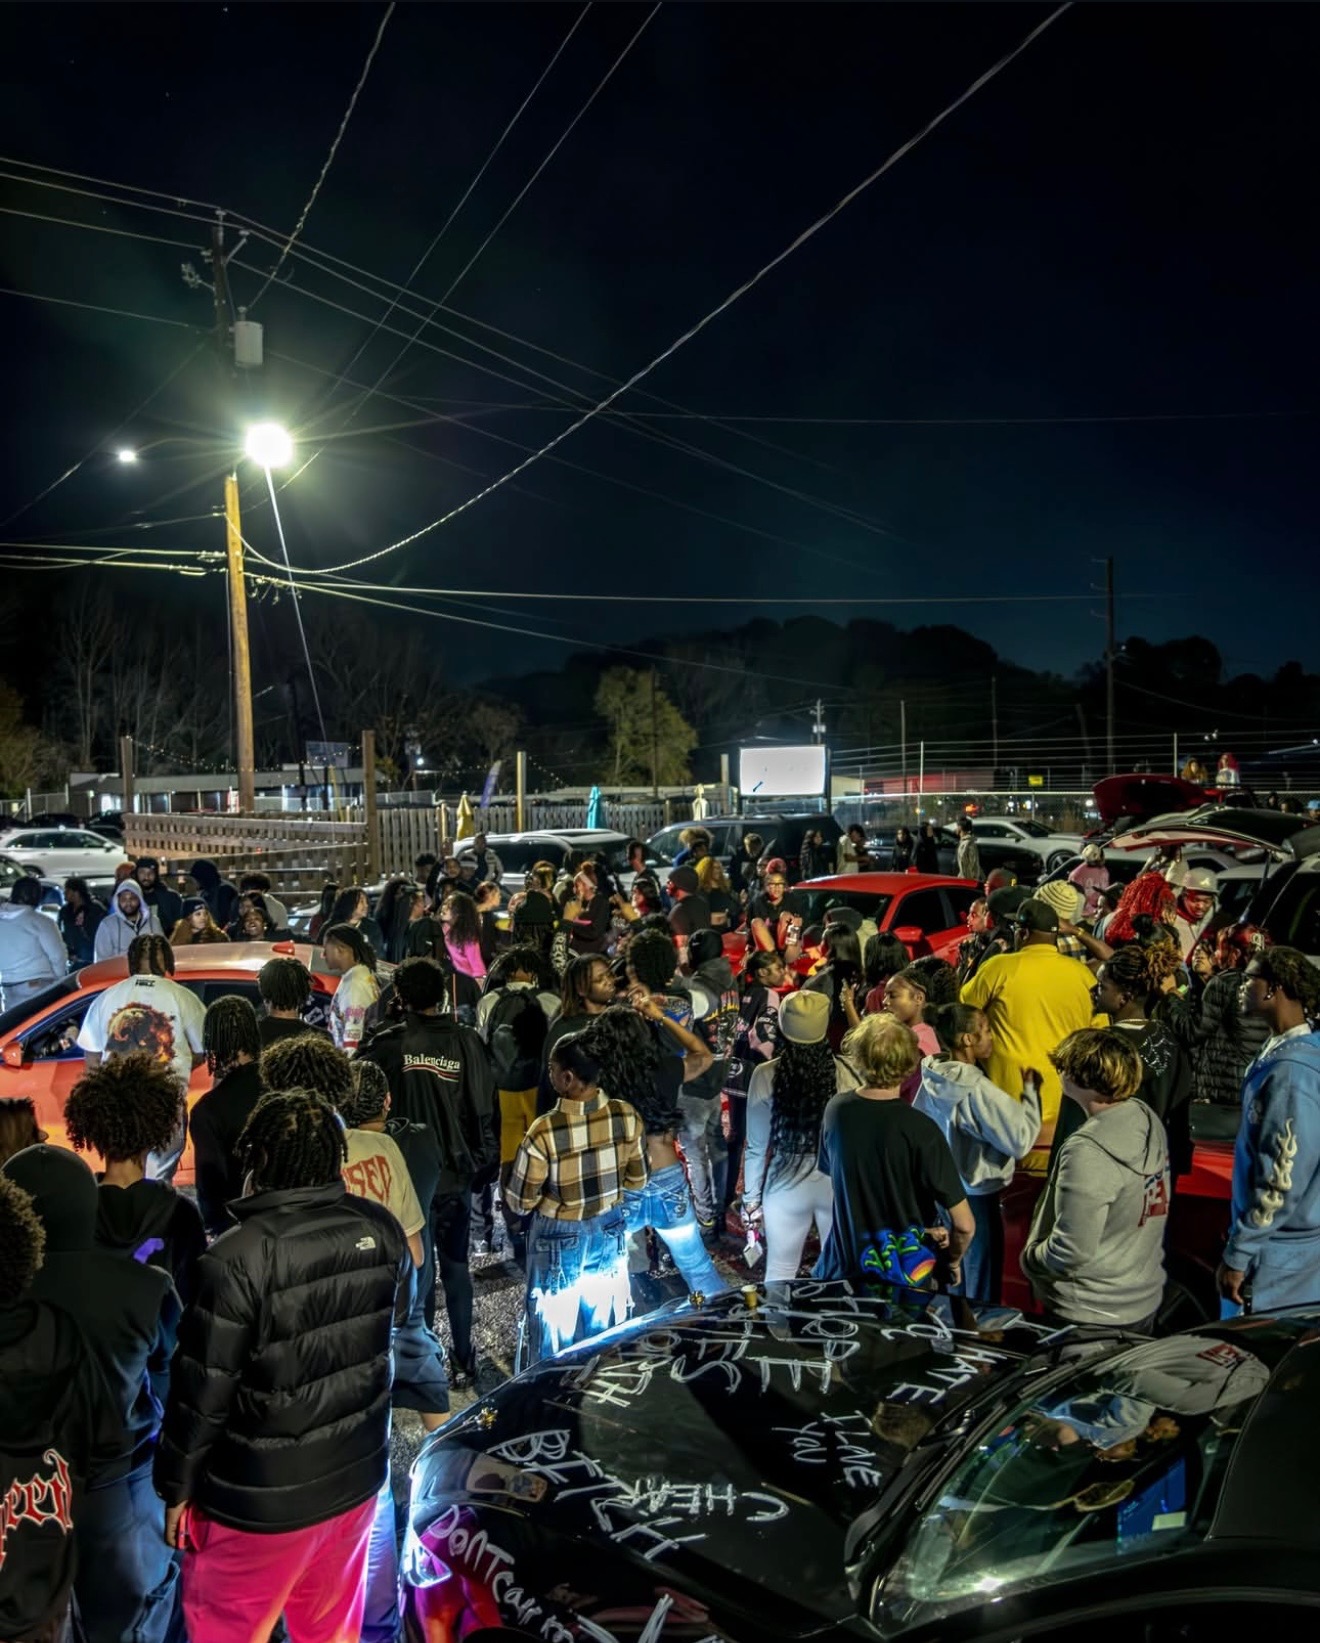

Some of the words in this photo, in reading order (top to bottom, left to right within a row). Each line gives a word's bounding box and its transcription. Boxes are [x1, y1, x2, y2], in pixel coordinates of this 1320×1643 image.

[403, 1053, 461, 1071] Balenciaga
[340, 1154, 392, 1206] SED
[886, 1343, 1009, 1405] HATE
